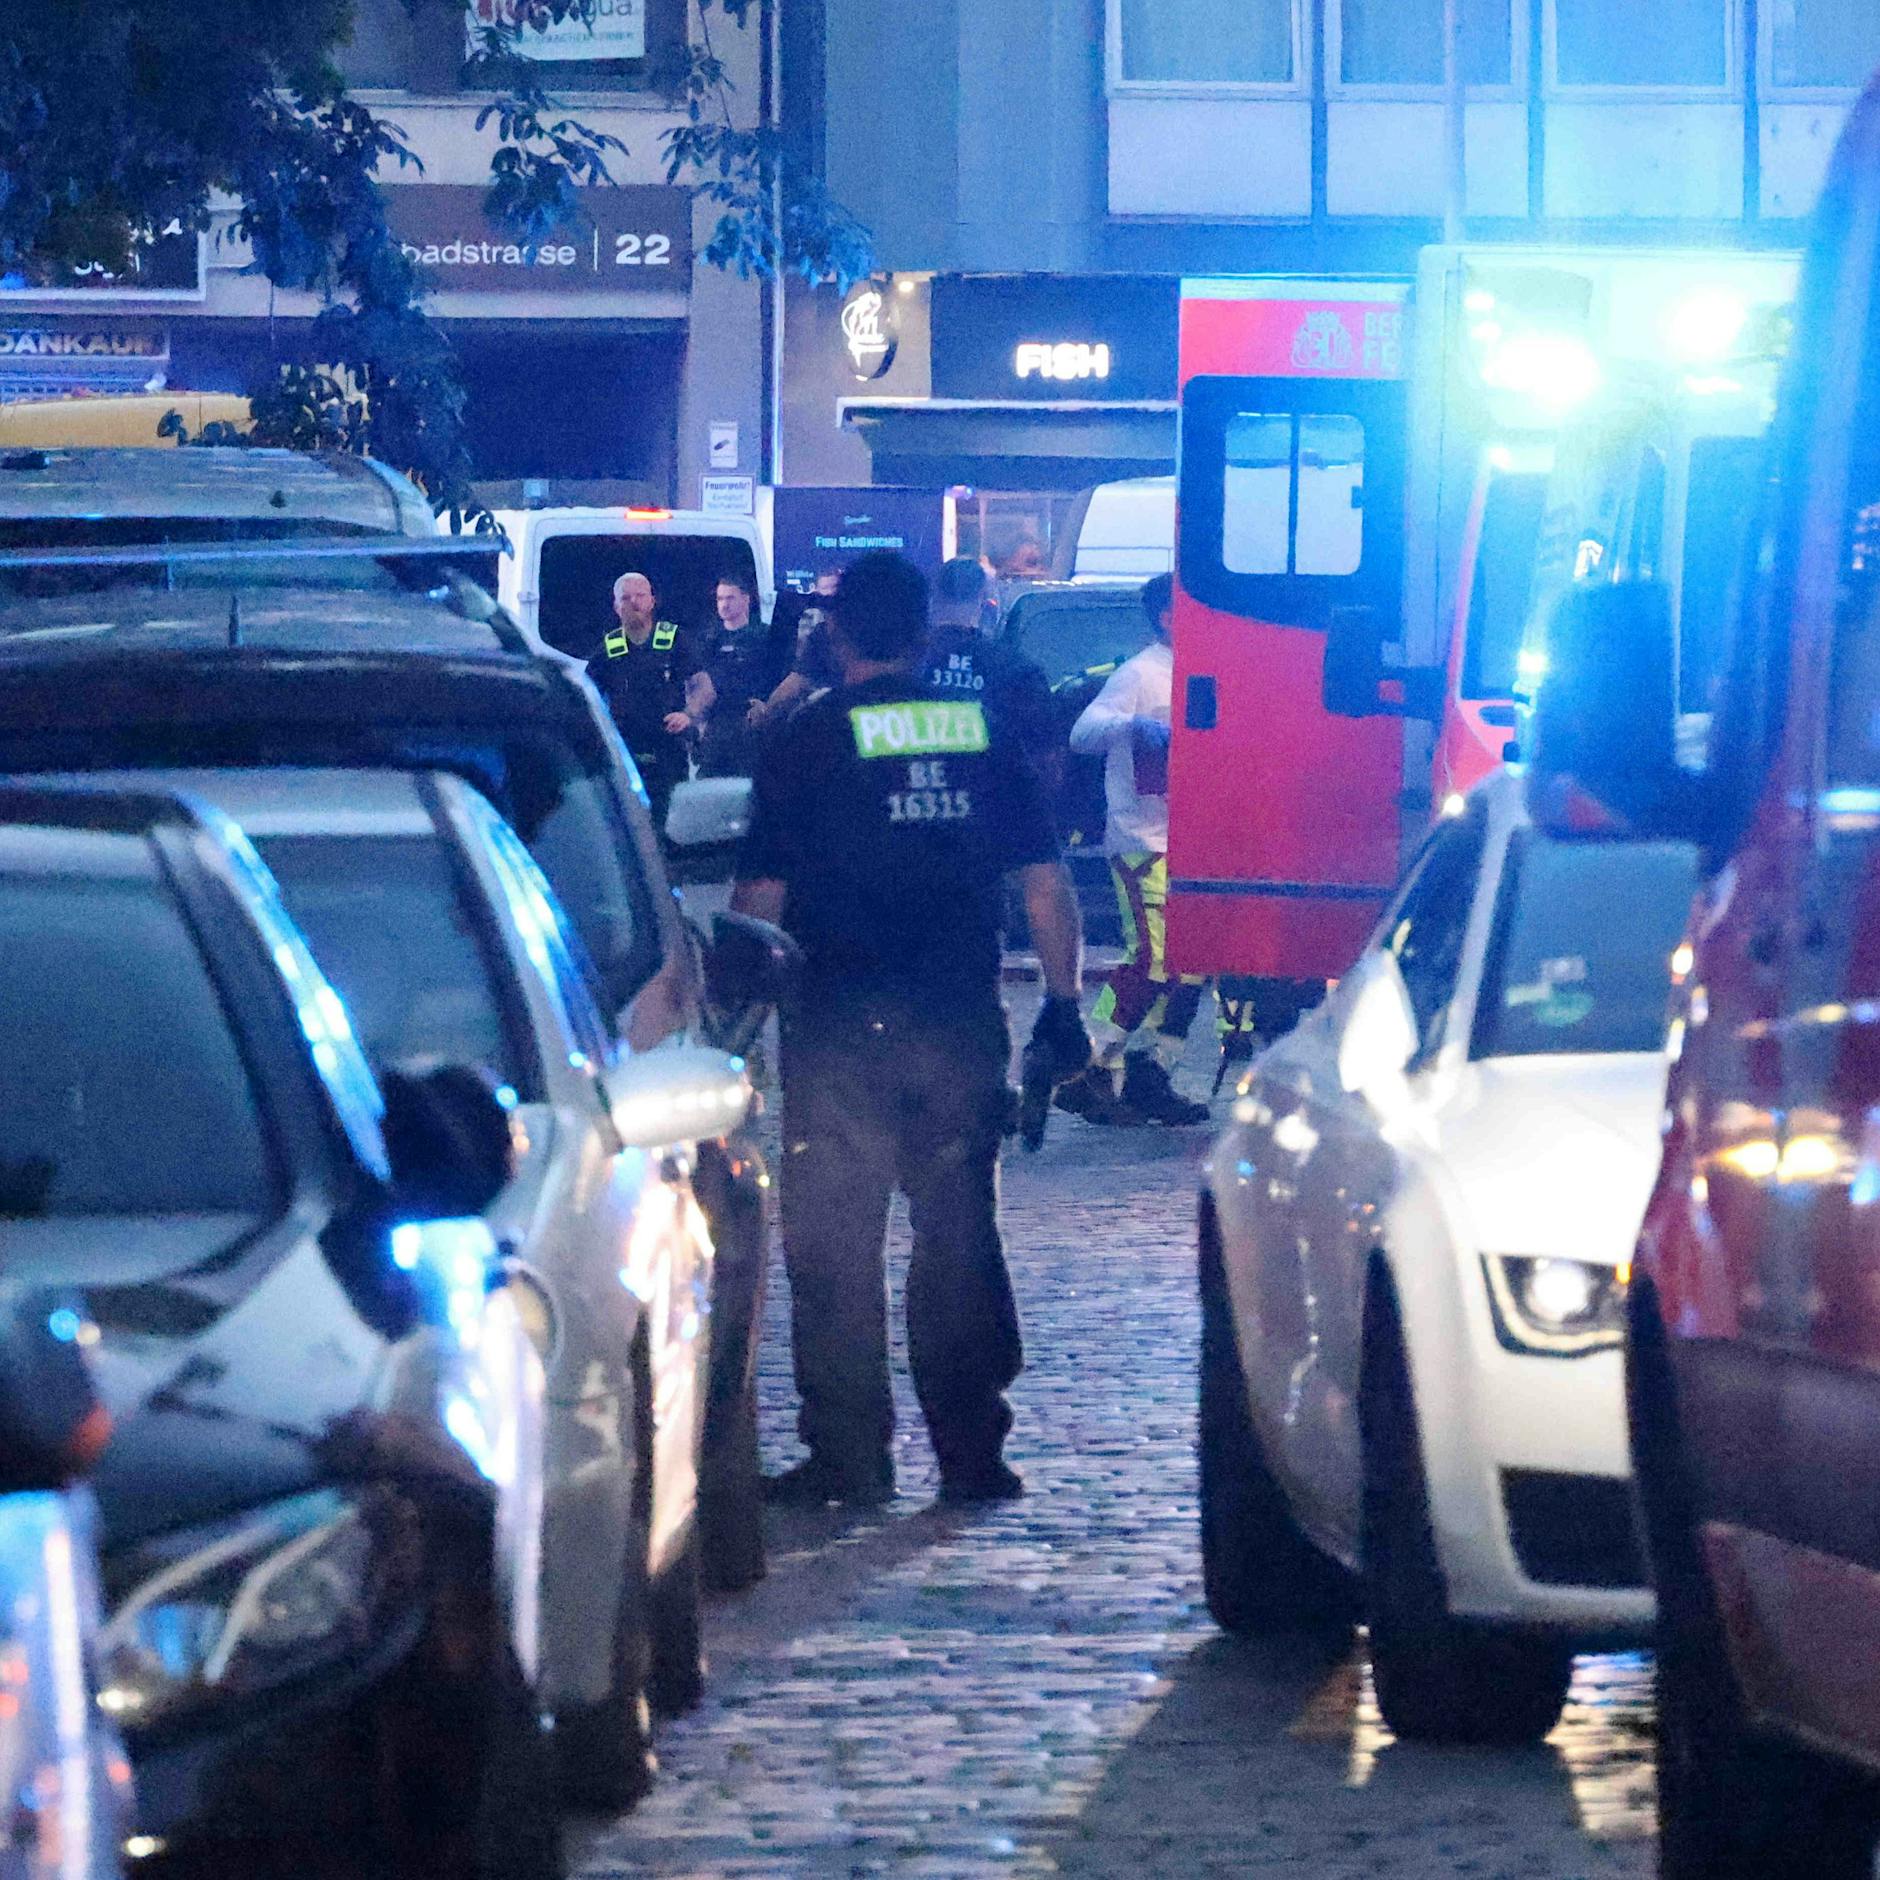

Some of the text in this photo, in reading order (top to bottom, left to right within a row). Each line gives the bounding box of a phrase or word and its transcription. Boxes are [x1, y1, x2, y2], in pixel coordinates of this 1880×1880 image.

[401, 233, 671, 265] badstrase 22
[1015, 342, 1110, 380] FISH
[949, 653, 973, 671] BE
[932, 668, 985, 690] 33120
[859, 708, 982, 750] POLIZEI
[909, 760, 948, 788] BE
[888, 789, 971, 821] 16315
